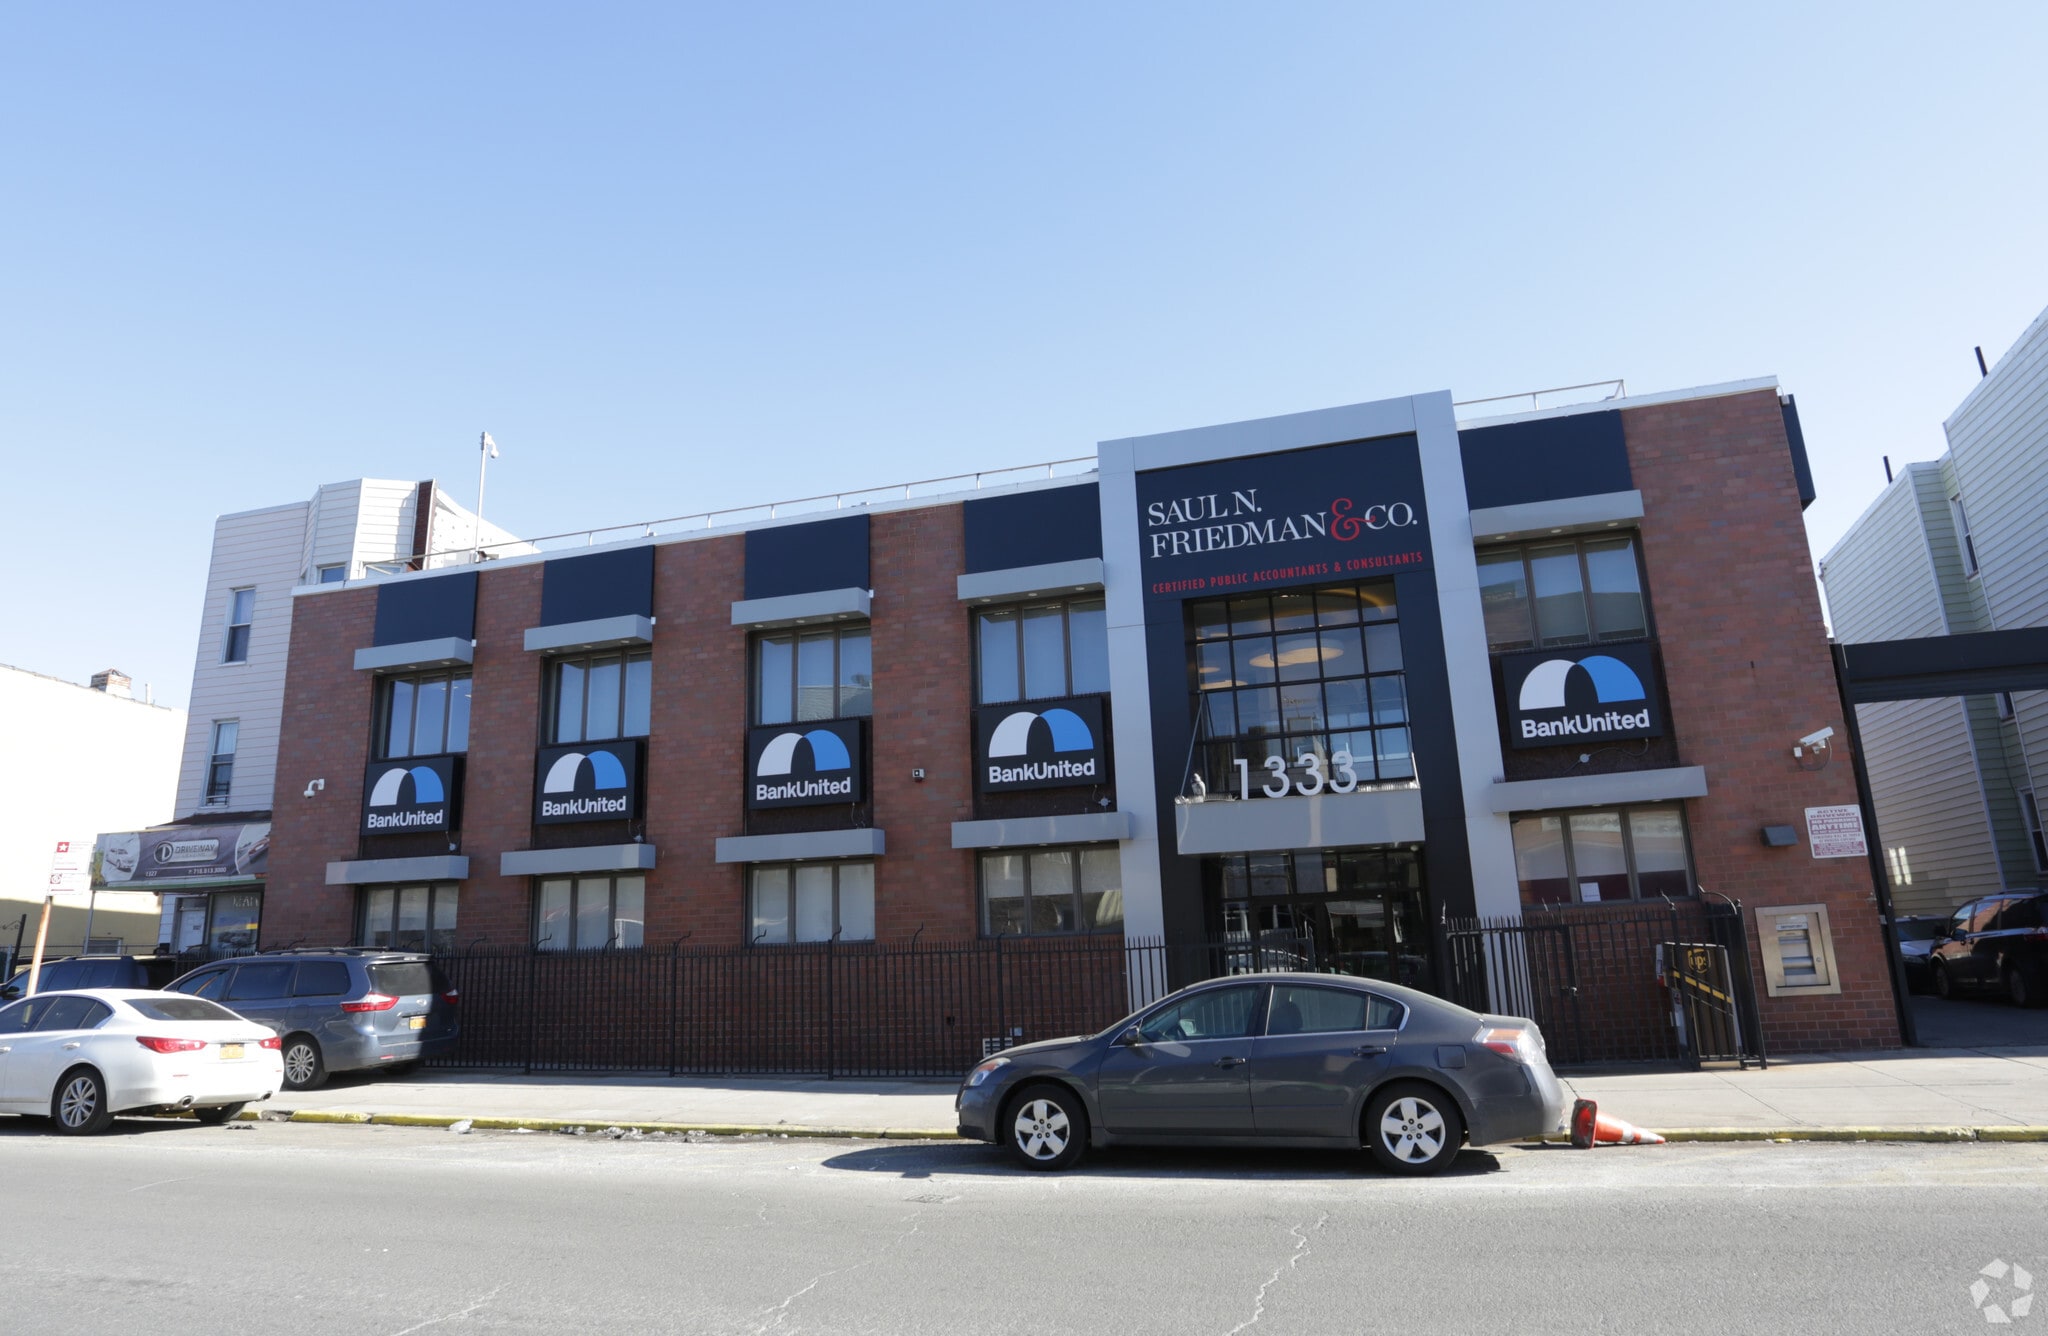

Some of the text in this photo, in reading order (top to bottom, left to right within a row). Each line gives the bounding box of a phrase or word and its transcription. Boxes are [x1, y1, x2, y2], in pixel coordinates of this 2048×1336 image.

[1147, 488, 1262, 527] SAUL N.
[1150, 497, 1418, 559] FRIEDMAN & CO.
[1152, 551, 1423, 594] CERTIFIED PUBLIC ACCOUNTANTS & CONSULTANTS
[1520, 708, 1651, 739] BankUnited
[988, 758, 1096, 784] BankUnited
[1233, 750, 1358, 801] 1333
[756, 776, 851, 801] BankUnited
[367, 809, 443, 829] BankUnited
[541, 795, 627, 817] BankUnited
[1811, 822, 1859, 830] ANYTIME
[175, 844, 215, 854] DRIVEWAY
